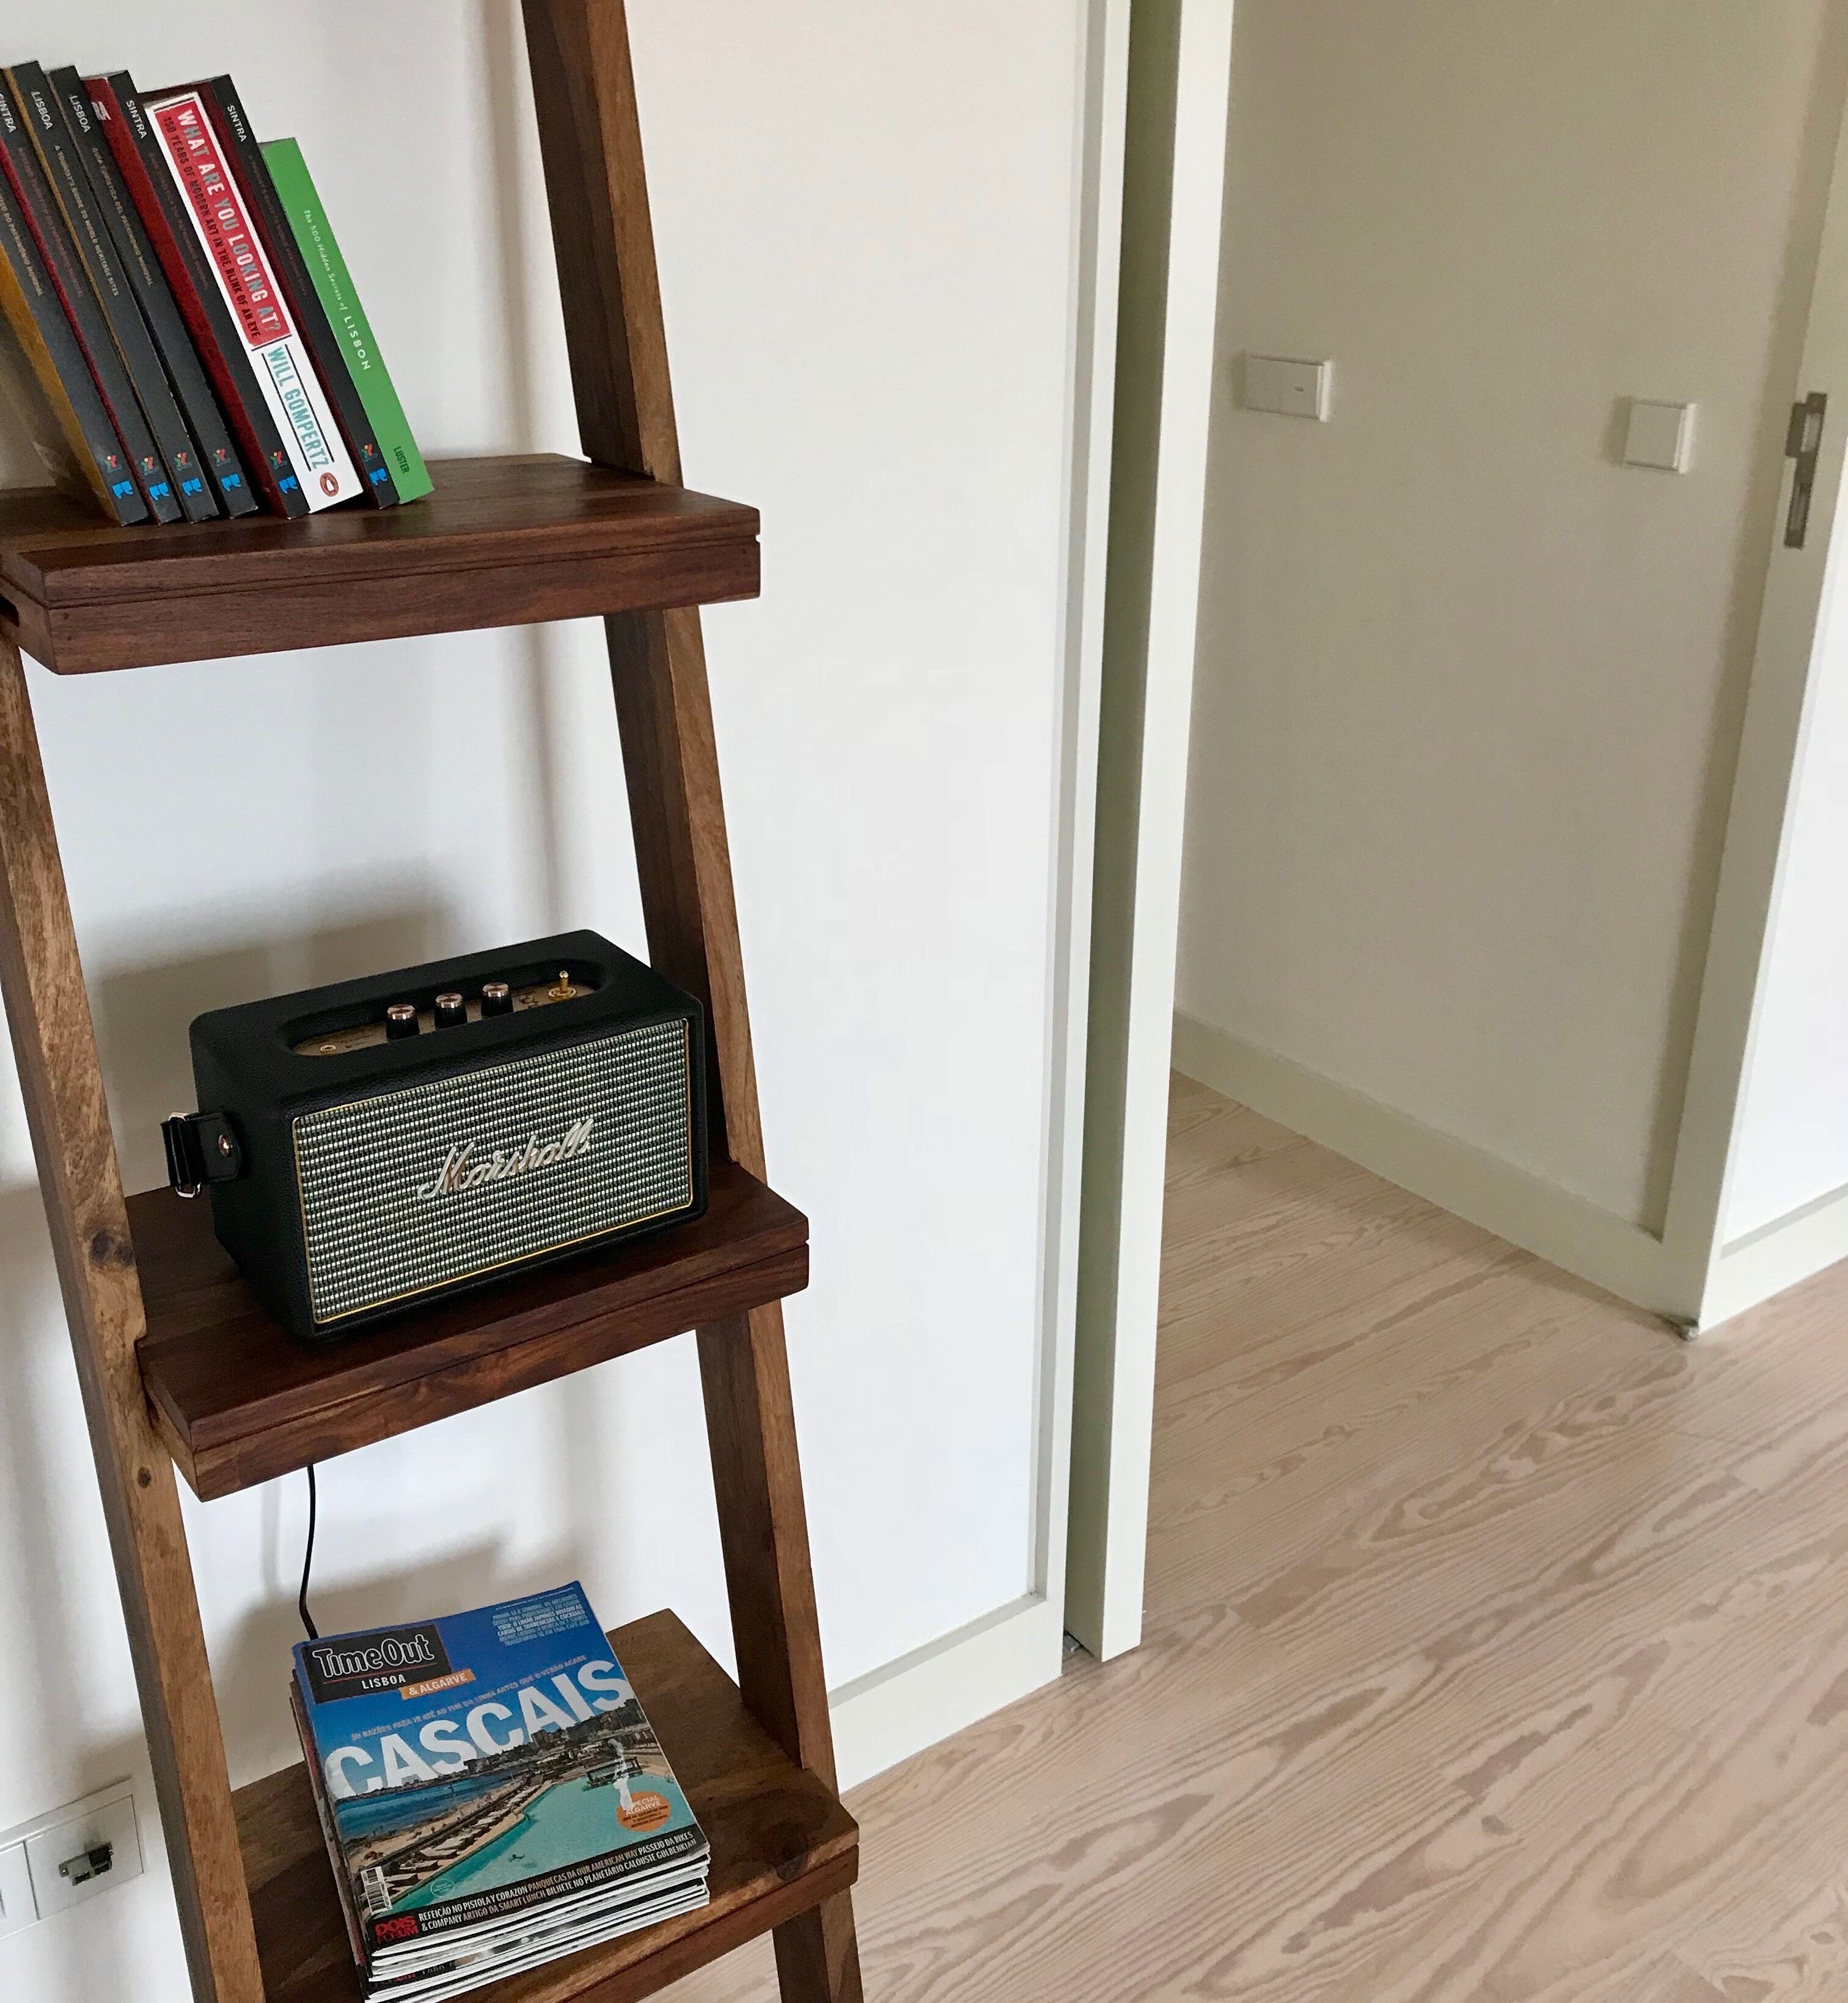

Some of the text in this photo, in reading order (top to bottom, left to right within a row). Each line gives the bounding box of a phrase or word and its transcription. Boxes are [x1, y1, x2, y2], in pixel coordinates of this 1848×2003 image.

[31, 91, 53, 130] LISBOA
[68, 95, 91, 133] LISBOA
[126, 100, 147, 139] SINTRA
[227, 105, 247, 142] SINTRA
[70, 186, 84, 210] GUIDE
[80, 210, 88, 219] TO
[84, 219, 98, 244] WORLD
[94, 244, 111, 277] HERITAGE
[107, 276, 119, 297] SITES
[114, 200, 124, 214] DEL
[163, 116, 261, 339] 150 YEARS OF MODERN ART IN THE BLINK OF AN EYE
[177, 109, 281, 332] WHAT ARE YOU LOOKING AT?
[302, 208, 371, 370] The 500 Hidden Secrets of LISBON
[268, 347, 329, 469] WILL GOMPERTZ
[394, 446, 410, 474] LUSTER
[417, 1119, 594, 1200] Marshall
[361, 1674, 406, 1689] LISBOA
[392, 1719, 412, 1729] PARA
[421, 1710, 436, 1721] ATÉ
[436, 1707, 447, 1716] AO
[448, 1702, 462, 1711] FIM
[462, 1697, 474, 1707] DA
[474, 1689, 496, 1703] LINHA
[496, 1681, 518, 1694] ANTES
[519, 1675, 534, 1686] QUE
[540, 1662, 563, 1677] VERÃO
[563, 1653, 587, 1667] ACABE
[408, 1672, 468, 1696] & ALGARVE
[325, 1660, 633, 1799] CASCAIS
[626, 1800, 662, 1815] ALGARVE
[418, 1830, 694, 1922] REFEIÇÃO NO PISTOLA Y CORAZON PANQUECAS DA OUR AMERICAN WAY PASSEIO DA BIKES
[420, 1923, 428, 1931] &
[427, 1914, 463, 1930] COMPANY
[461, 1906, 488, 1922] ARTIGO
[488, 1904, 499, 1914] DA
[498, 1897, 523, 1911] SMART
[521, 1889, 546, 1904] LUNCH
[545, 1880, 573, 1896] BILHETE
[573, 1877, 584, 1887] NO
[624, 1853, 657, 1870] CALOUSTE
[656, 1838, 697, 1859] GULBENKIAN
